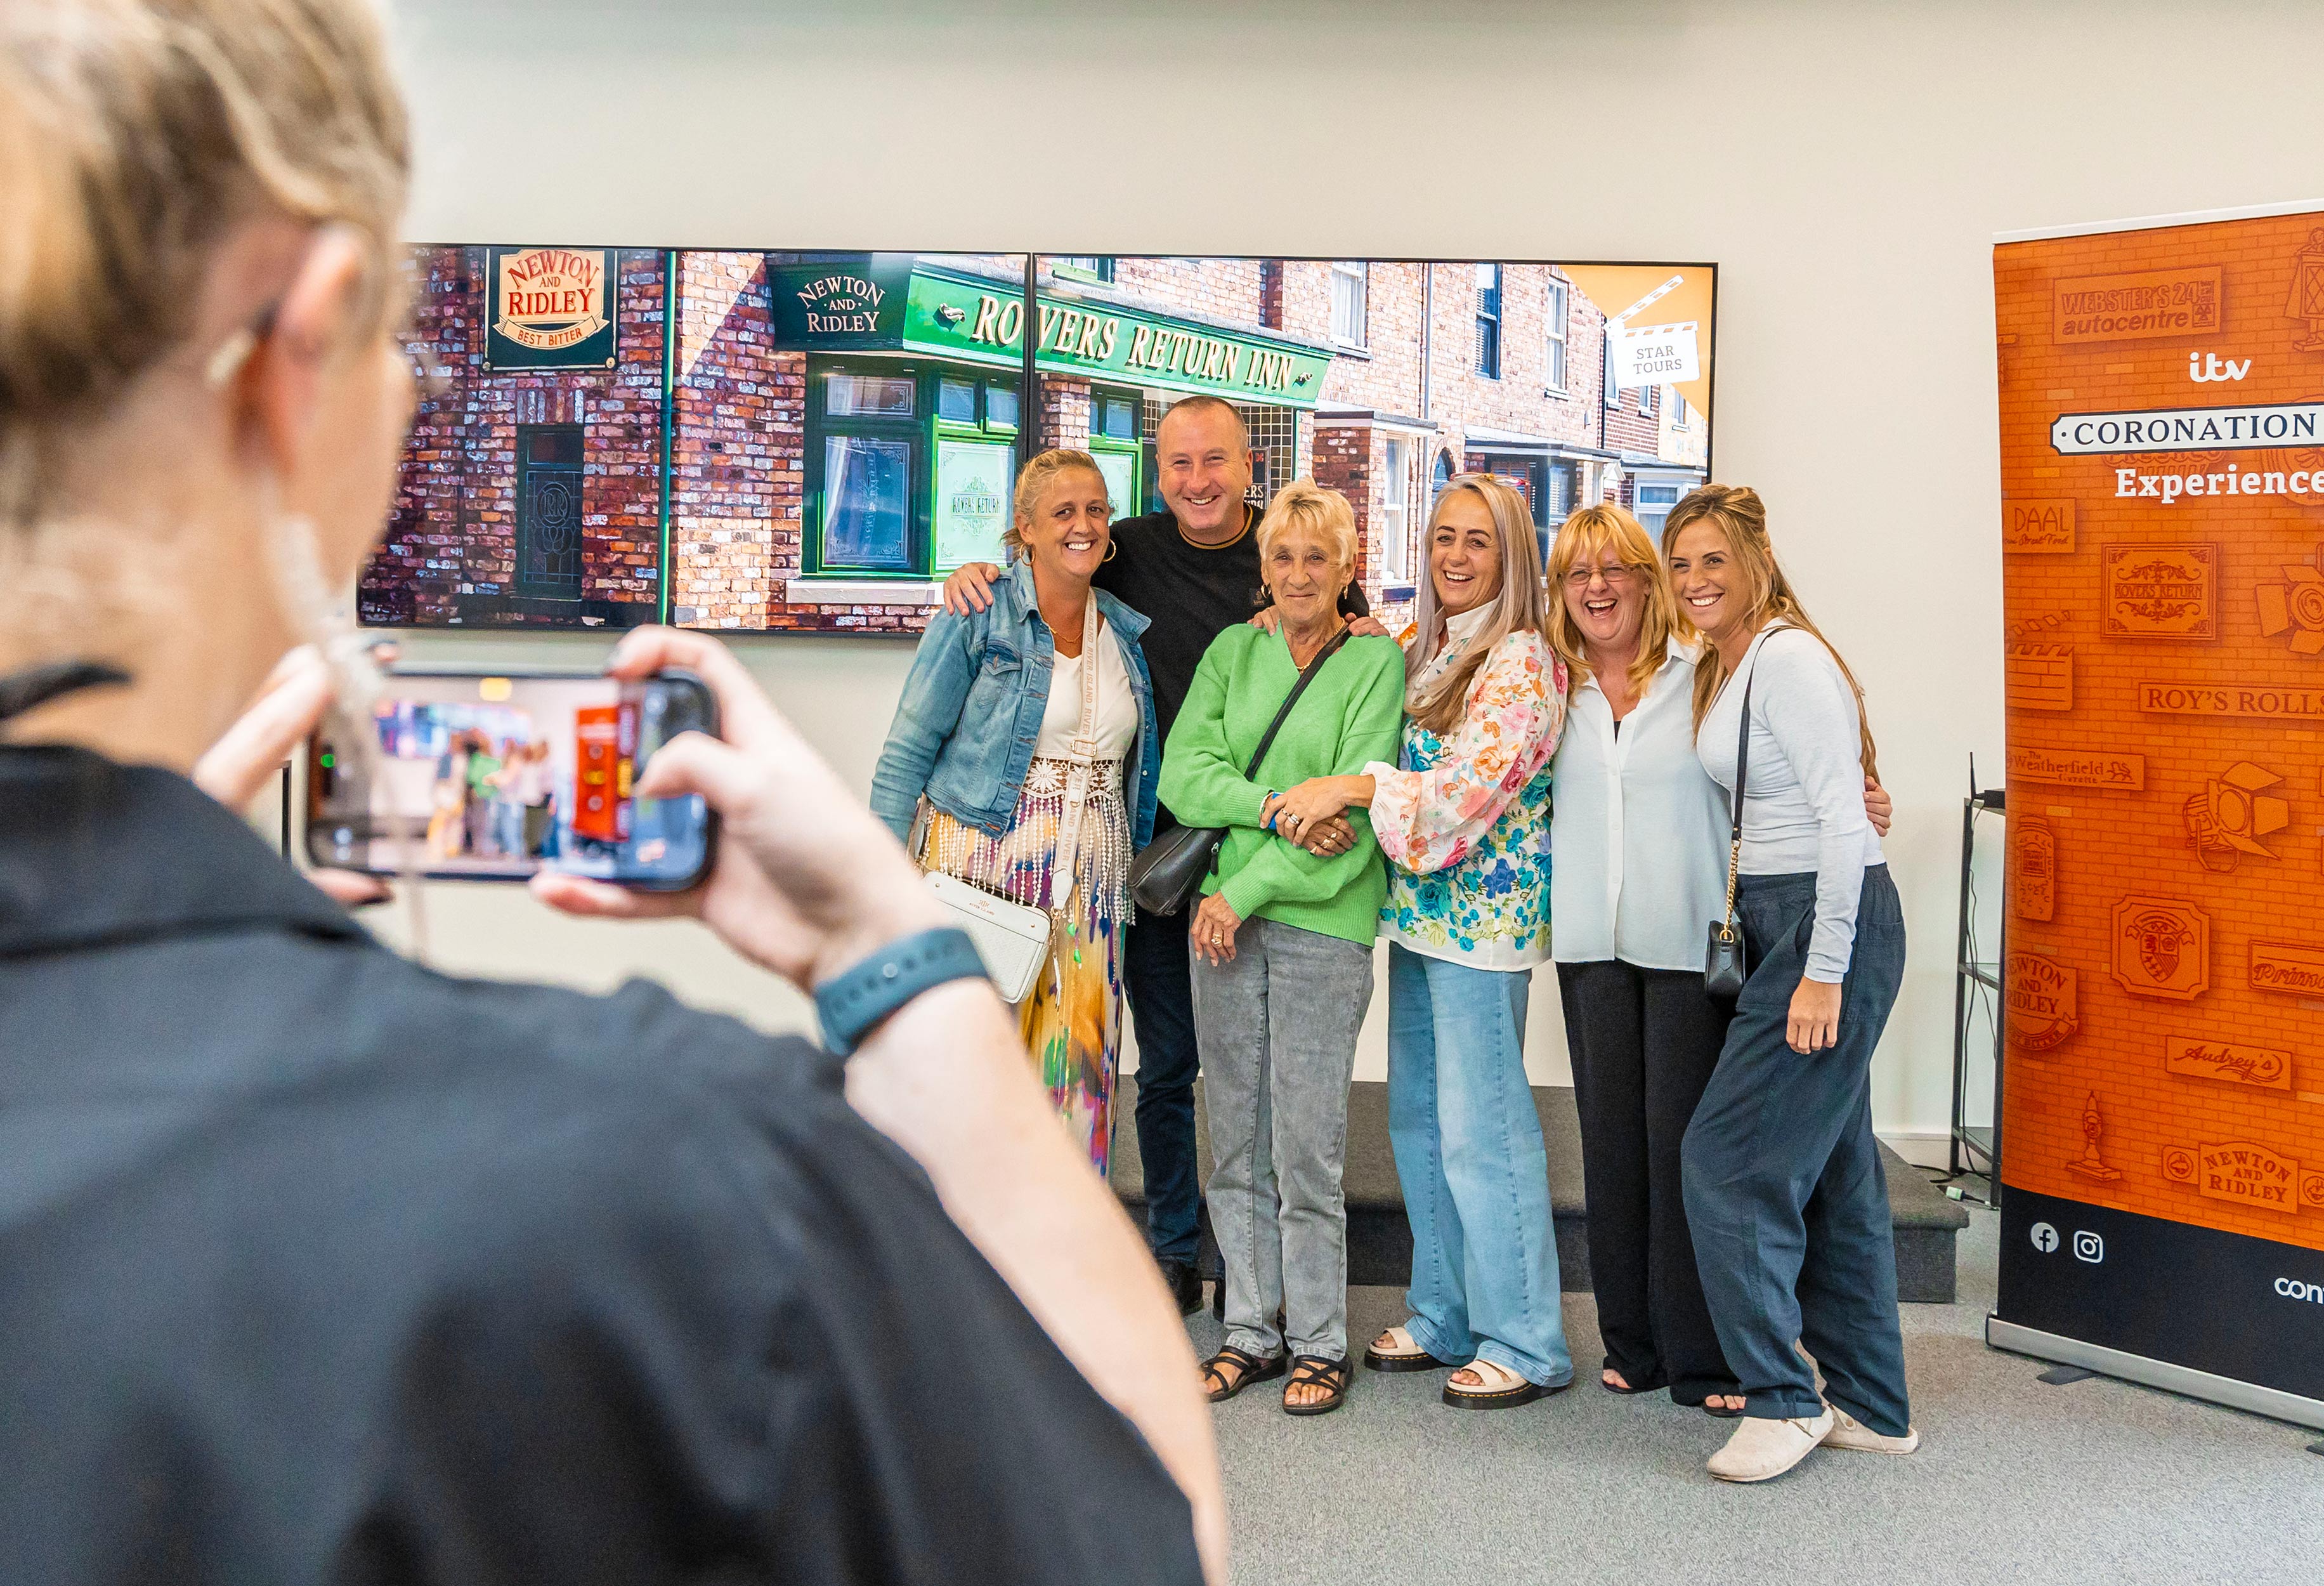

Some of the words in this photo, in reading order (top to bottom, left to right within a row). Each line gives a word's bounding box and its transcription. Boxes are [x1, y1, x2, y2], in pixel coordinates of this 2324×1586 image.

[507, 250, 600, 290] NEWTON
[539, 276, 561, 288] AND
[507, 288, 596, 317] RIDLEY
[797, 275, 885, 309] NEWTON
[828, 299, 856, 311] AND
[2062, 285, 2170, 315] WEBSTER'S
[806, 311, 880, 333] RIDLEY
[2062, 310, 2189, 336] autocentre
[518, 330, 542, 346] BEST
[549, 327, 582, 346] BITTER
[971, 294, 1120, 360] ROVERS
[1127, 324, 1243, 380] RETURN
[1245, 348, 1296, 390] INN
[1636, 345, 1675, 360] STAR
[1633, 358, 1682, 374] TOURS
[2190, 351, 2252, 383] itv
[2074, 413, 2316, 445] CORONATION
[2115, 464, 2324, 504] Experience
[953, 497, 975, 513] ROVERS
[977, 497, 1000, 513] RETURN
[2014, 506, 2070, 532] DAAL
[2115, 585, 2156, 598] ROVERS
[2160, 586, 2203, 598] RETURN
[1086, 646, 1094, 671] RIVER
[1085, 672, 1093, 704] ISLAND
[2236, 691, 2324, 714] ROLL
[1083, 707, 1092, 735] RIVER
[2014, 756, 2104, 775] Weatherfield
[1062, 832, 1073, 861] RIVER
[2017, 979, 2041, 993] AND
[2173, 1046, 2274, 1080] Audrey's
[2203, 1151, 2292, 1183] NEWTON
[2233, 1167, 2263, 1181] AND
[2208, 1173, 2288, 1203] RIDLEY
[2274, 1277, 2324, 1304] con
